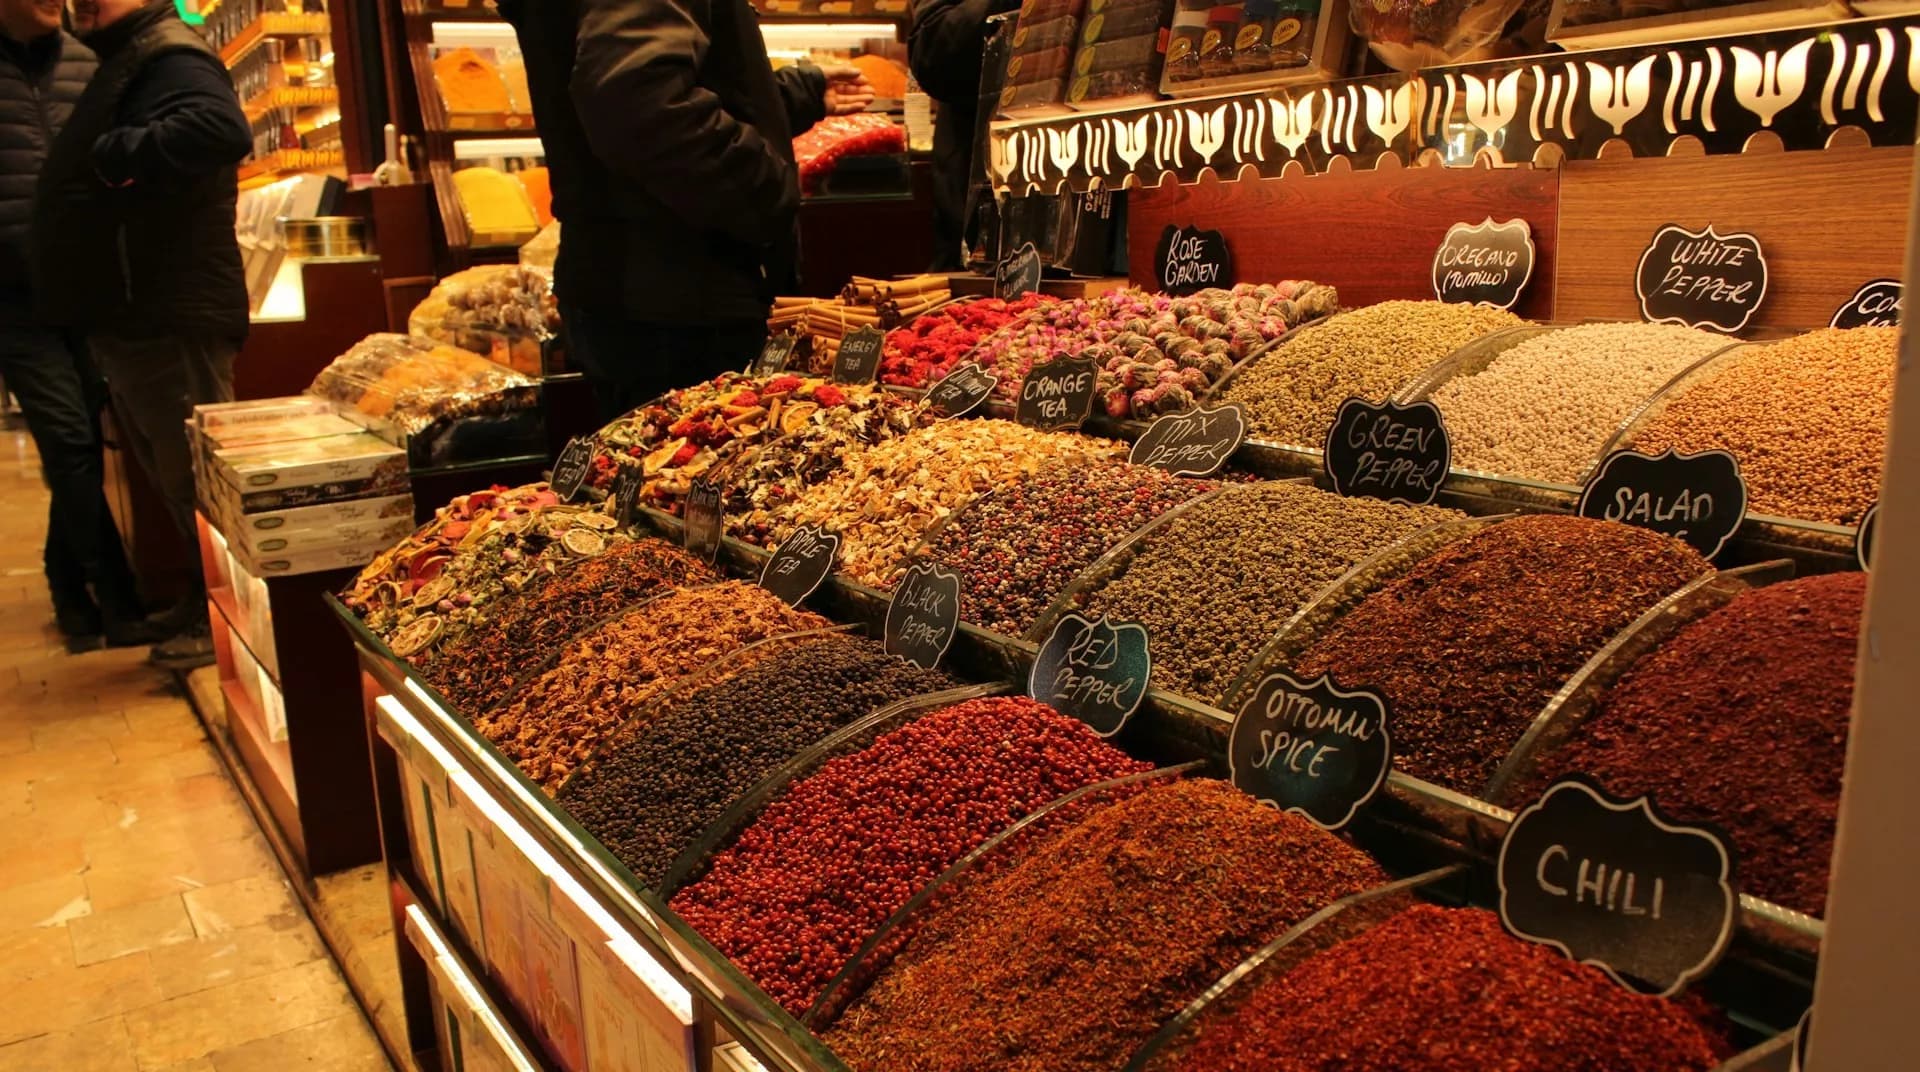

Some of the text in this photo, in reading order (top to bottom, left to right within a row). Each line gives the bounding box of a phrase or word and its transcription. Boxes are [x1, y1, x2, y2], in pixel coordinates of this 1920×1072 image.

[1167, 230, 1208, 262] ROSE
[1442, 245, 1518, 267] OREGANO
[1671, 239, 1755, 267] WHITE
[1165, 260, 1219, 286] GARDEN
[1650, 266, 1753, 304] PEPPER
[841, 340, 877, 354] ENERGY
[845, 358, 861, 371] TEA
[1024, 372, 1091, 400] ORANGE
[1037, 398, 1067, 418] TEA
[1155, 416, 1218, 446] MIX
[1348, 411, 1436, 453] GREEN
[1142, 438, 1230, 467] PEPPER
[1349, 451, 1439, 490] PEPPER
[1604, 486, 1713, 522] SALAD
[784, 531, 829, 559] APPLE
[771, 556, 800, 575] TEA
[900, 615, 946, 650] PEPPER
[1057, 625, 1119, 669] RED
[1051, 668, 1135, 710] PEPPER
[1266, 688, 1379, 741] OTTOMAN
[1251, 729, 1341, 777] SPICE
[1536, 844, 1664, 919] CHILI
